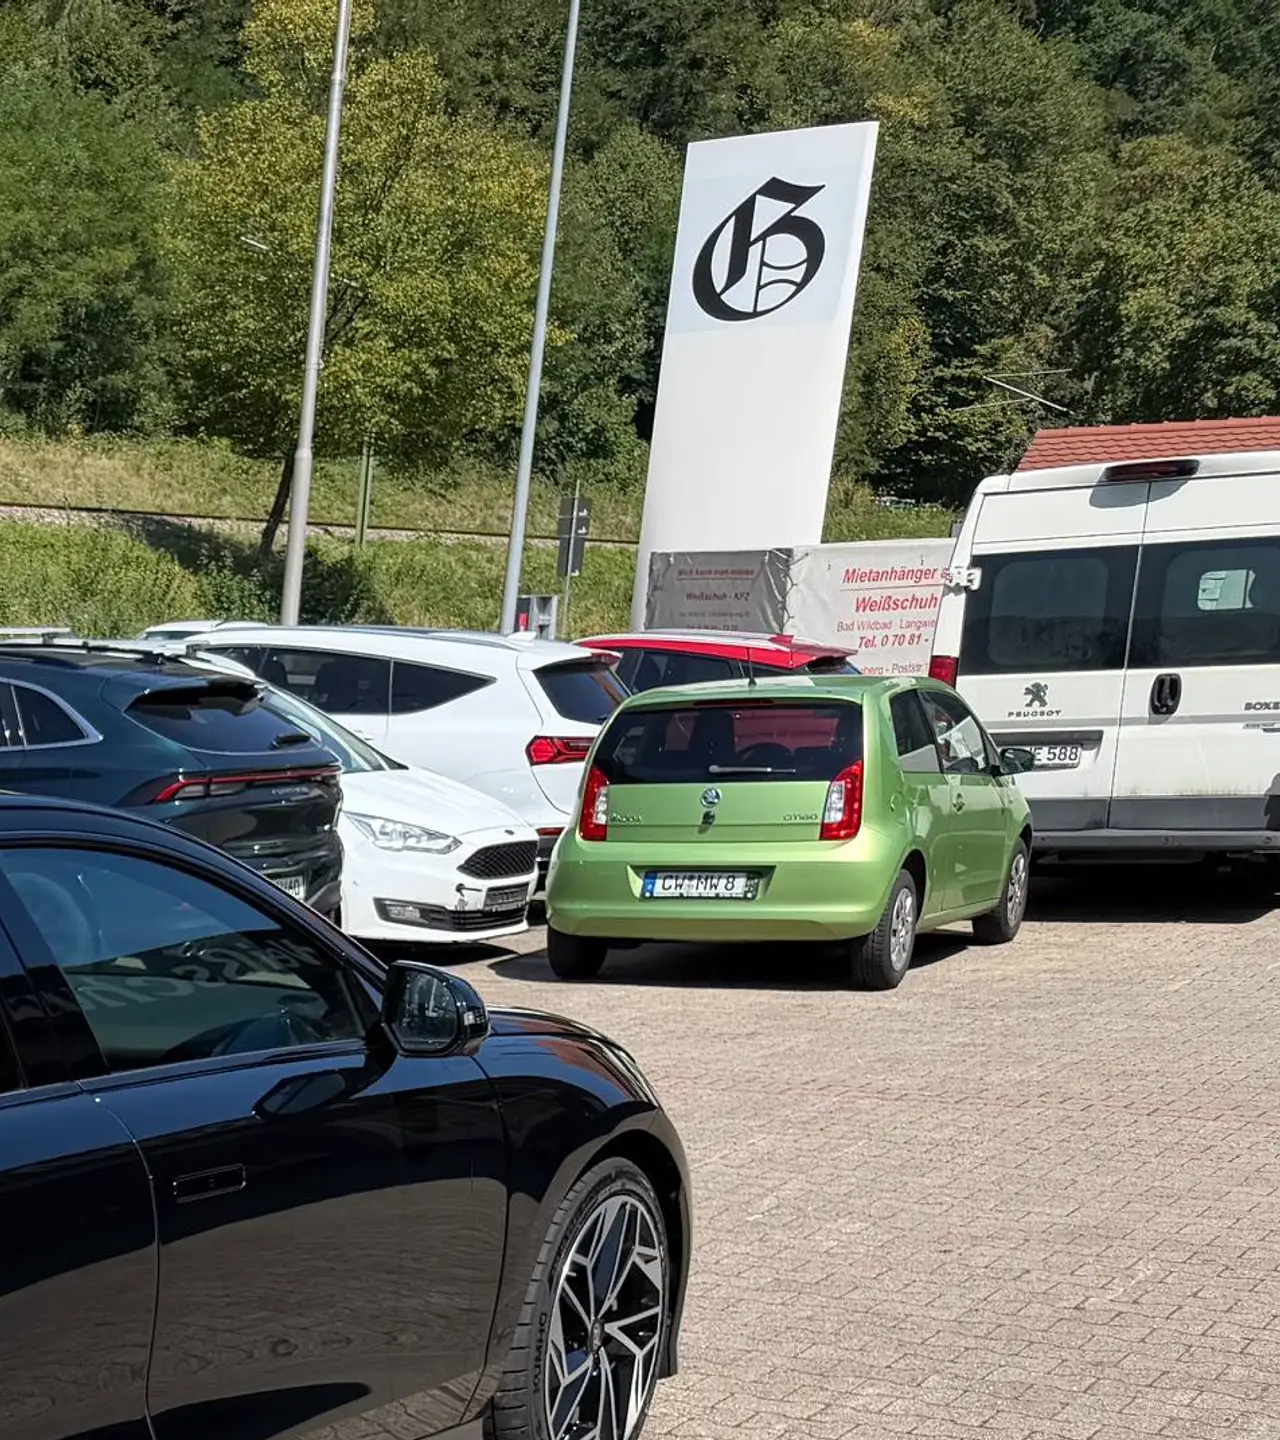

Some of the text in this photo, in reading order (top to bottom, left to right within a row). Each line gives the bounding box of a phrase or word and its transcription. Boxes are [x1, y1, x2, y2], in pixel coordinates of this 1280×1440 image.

[842, 566, 938, 584] Mietanhänger
[855, 594, 939, 613] Weißschuh
[837, 622, 854, 632] Bad
[856, 620, 893, 632] Wildbad
[858, 635, 877, 649] Tel.
[881, 635, 889, 647] 0
[891, 634, 907, 646] 70
[907, 633, 921, 646] 81
[1007, 709, 1062, 718] PEUGEOT
[1046, 746, 1079, 761] 588
[662, 874, 736, 891] CW MW 8
